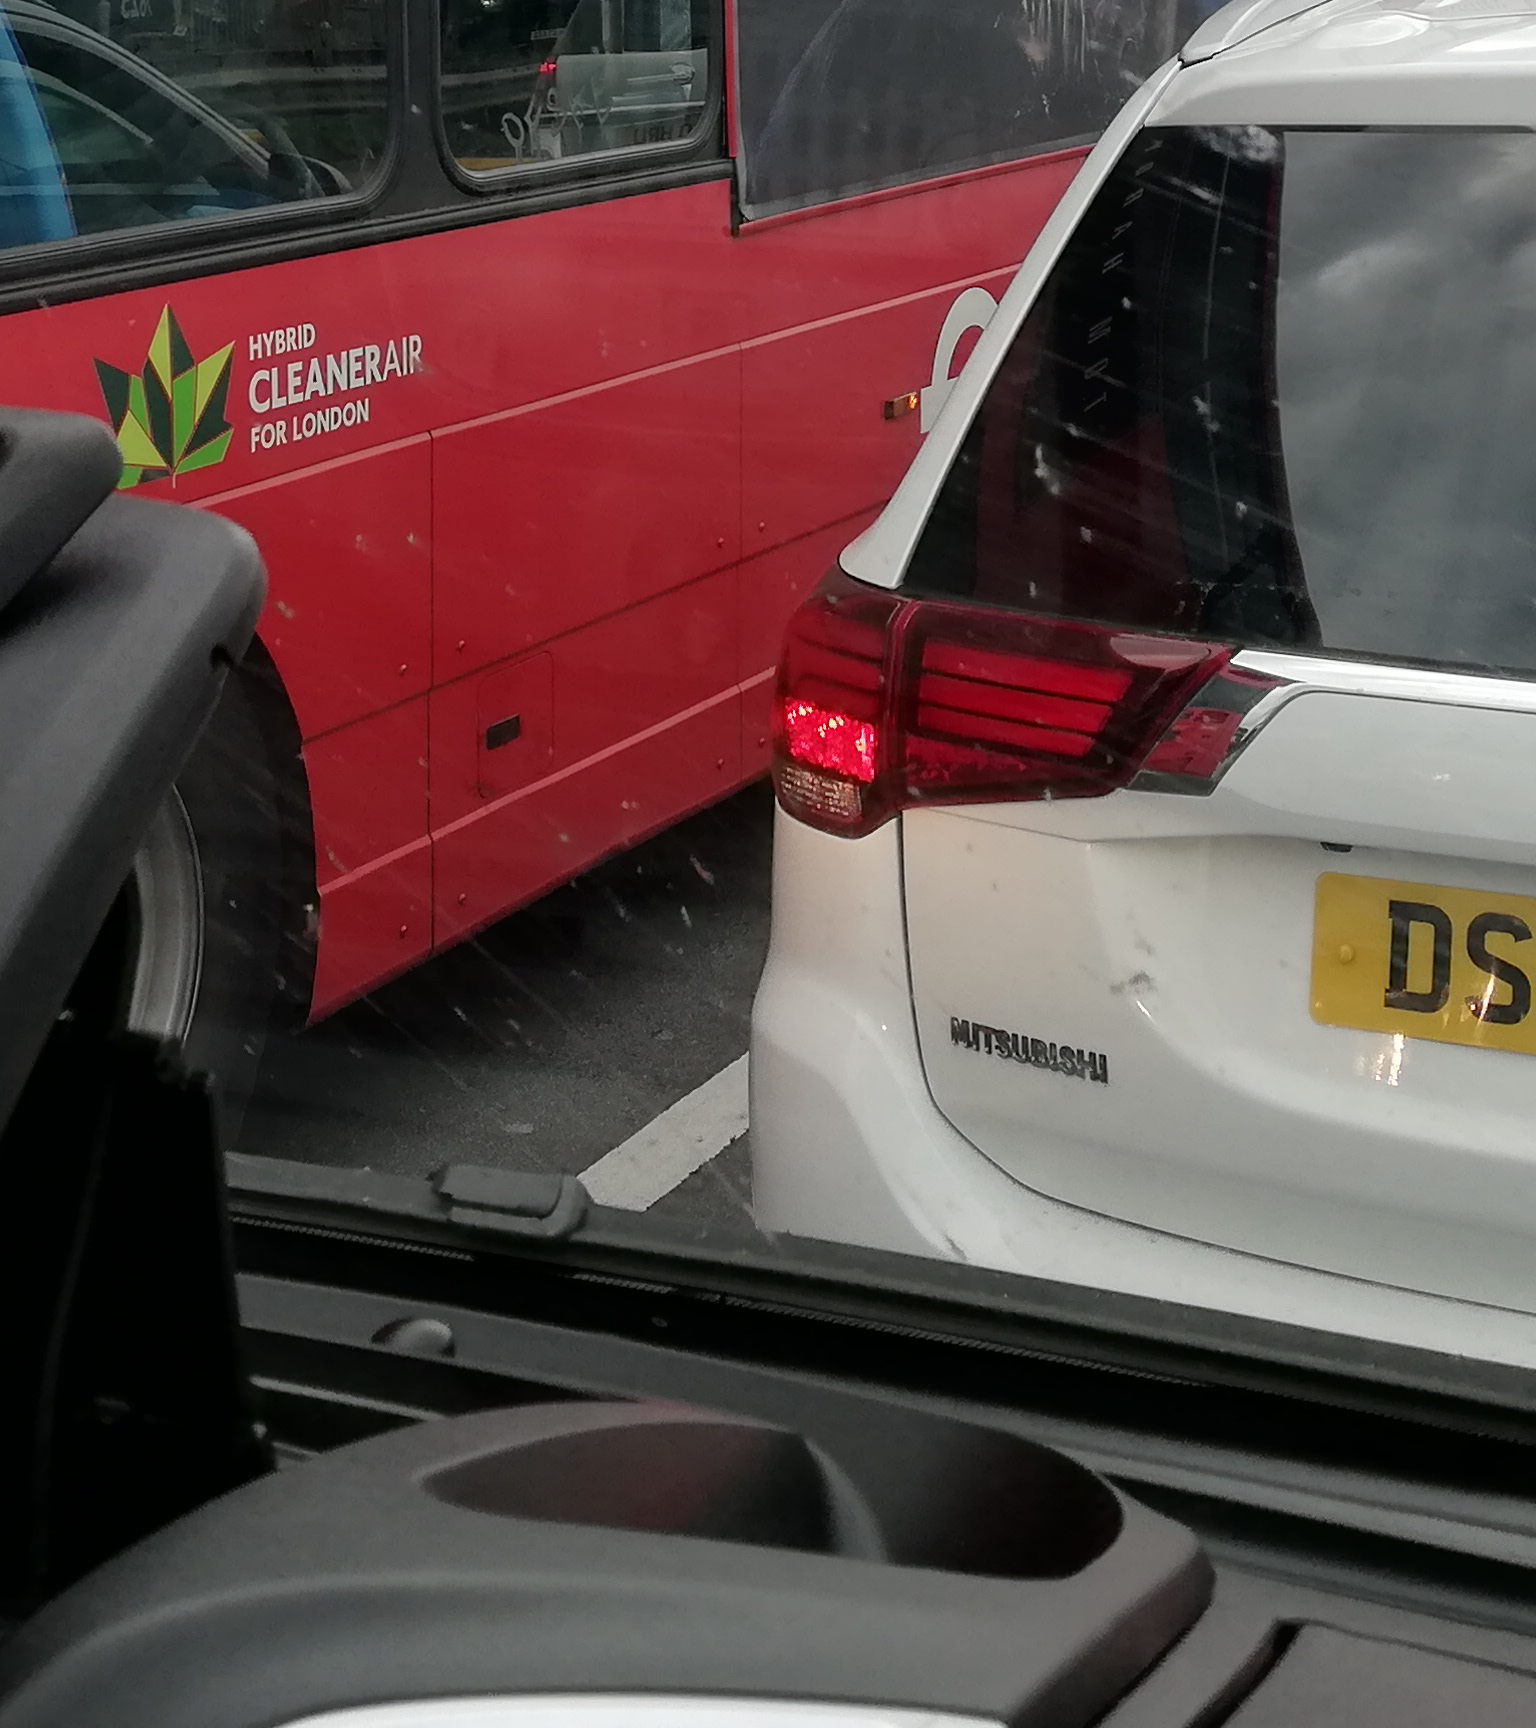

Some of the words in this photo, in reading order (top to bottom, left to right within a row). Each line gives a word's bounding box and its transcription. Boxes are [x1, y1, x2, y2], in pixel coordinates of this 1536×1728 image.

[248, 322, 316, 361] HYBRID
[250, 420, 287, 453] FOR
[292, 398, 370, 442] LONDON
[950, 1015, 1109, 1086] MITSUBISHI
